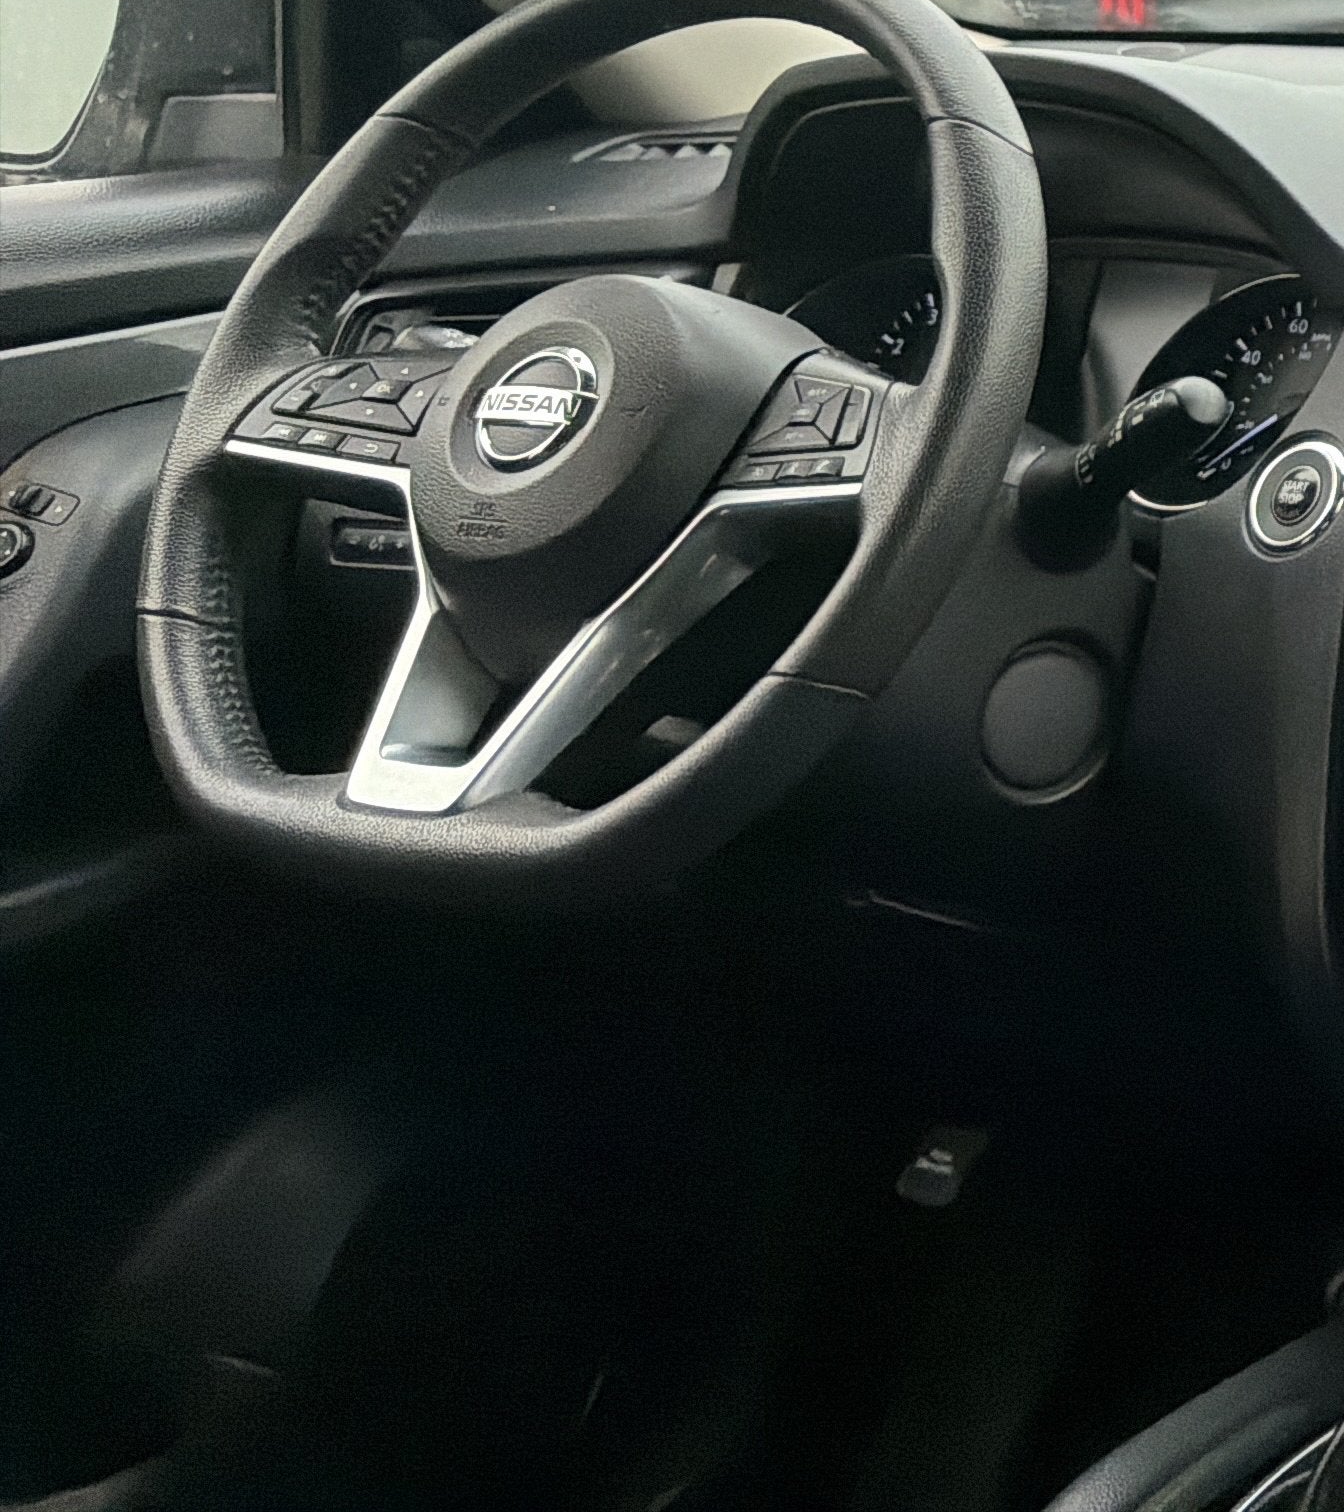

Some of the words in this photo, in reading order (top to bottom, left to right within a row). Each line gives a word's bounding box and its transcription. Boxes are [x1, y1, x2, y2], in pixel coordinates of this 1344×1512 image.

[1288, 318, 1309, 335] 60
[1241, 349, 1262, 366] 40
[482, 393, 582, 419] NISSAN
